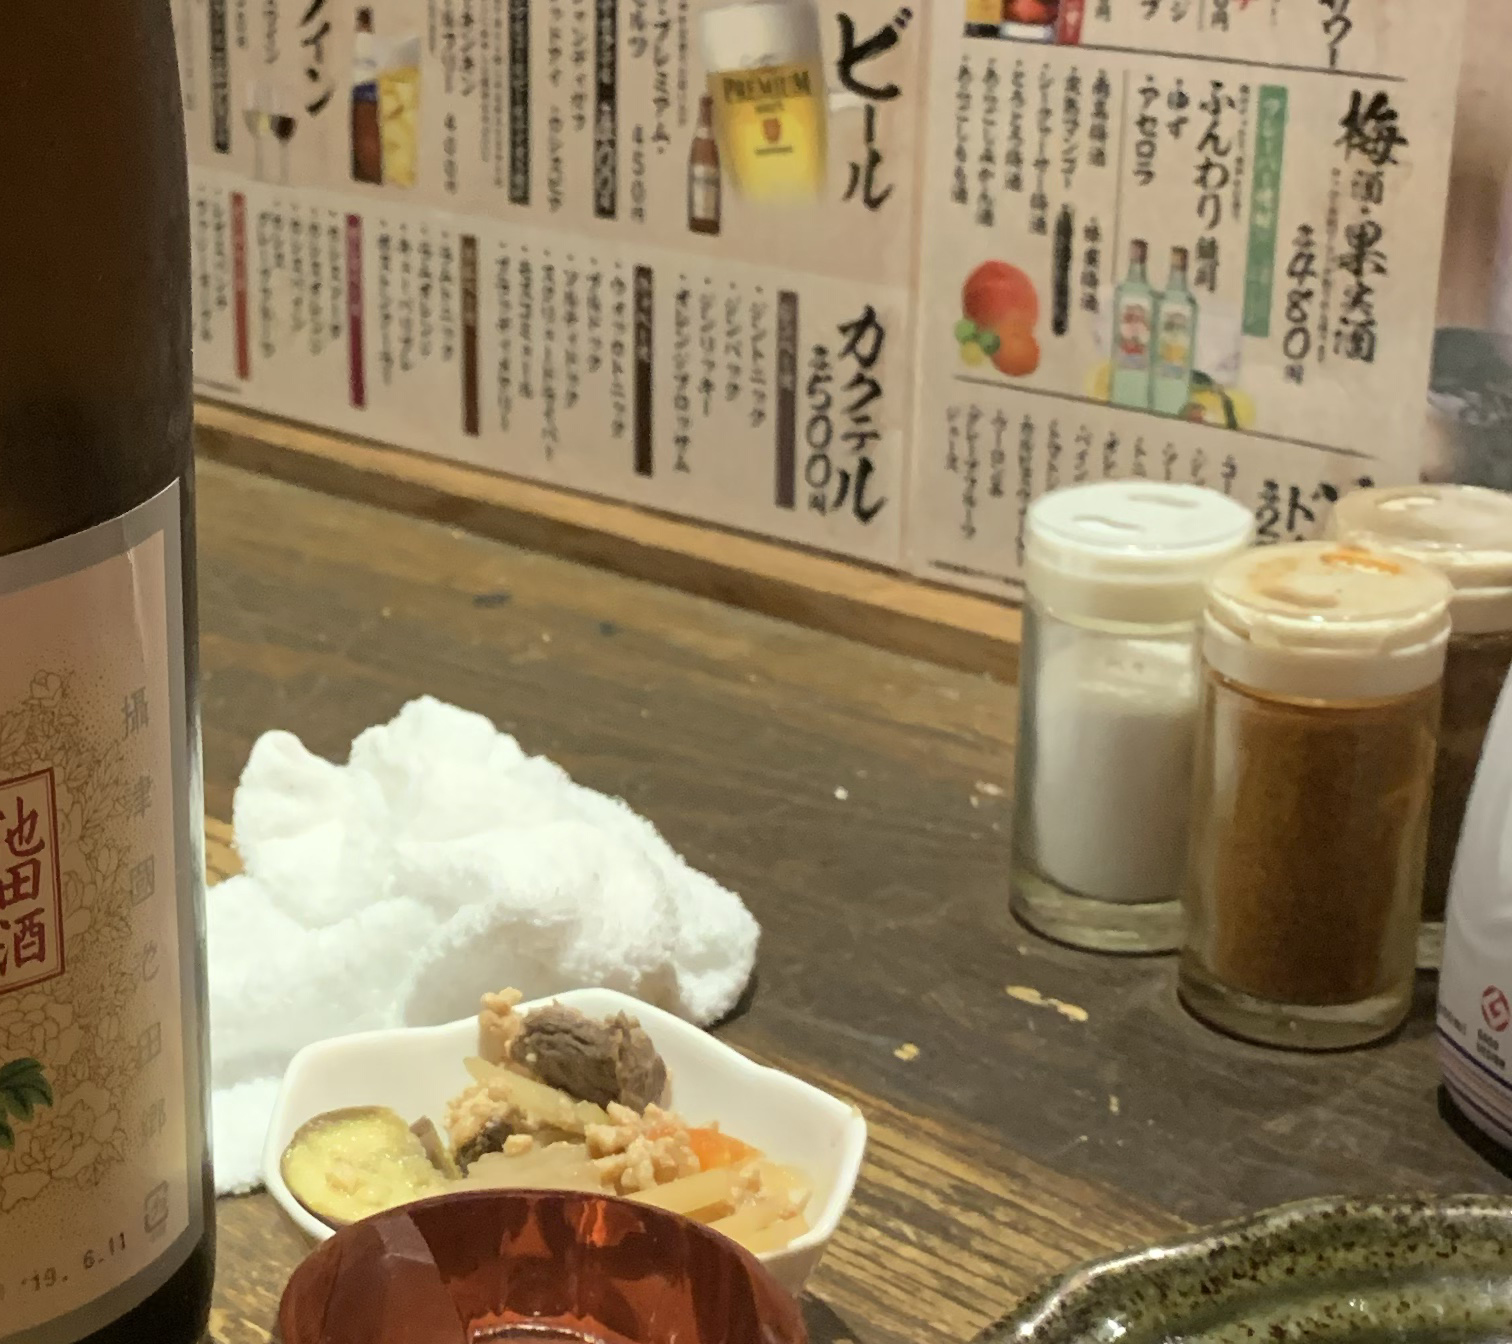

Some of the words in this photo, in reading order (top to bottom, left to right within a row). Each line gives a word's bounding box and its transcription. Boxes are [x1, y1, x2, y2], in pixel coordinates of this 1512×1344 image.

[835, 6, 914, 211] ビール
[835, 304, 890, 524] カクテル
